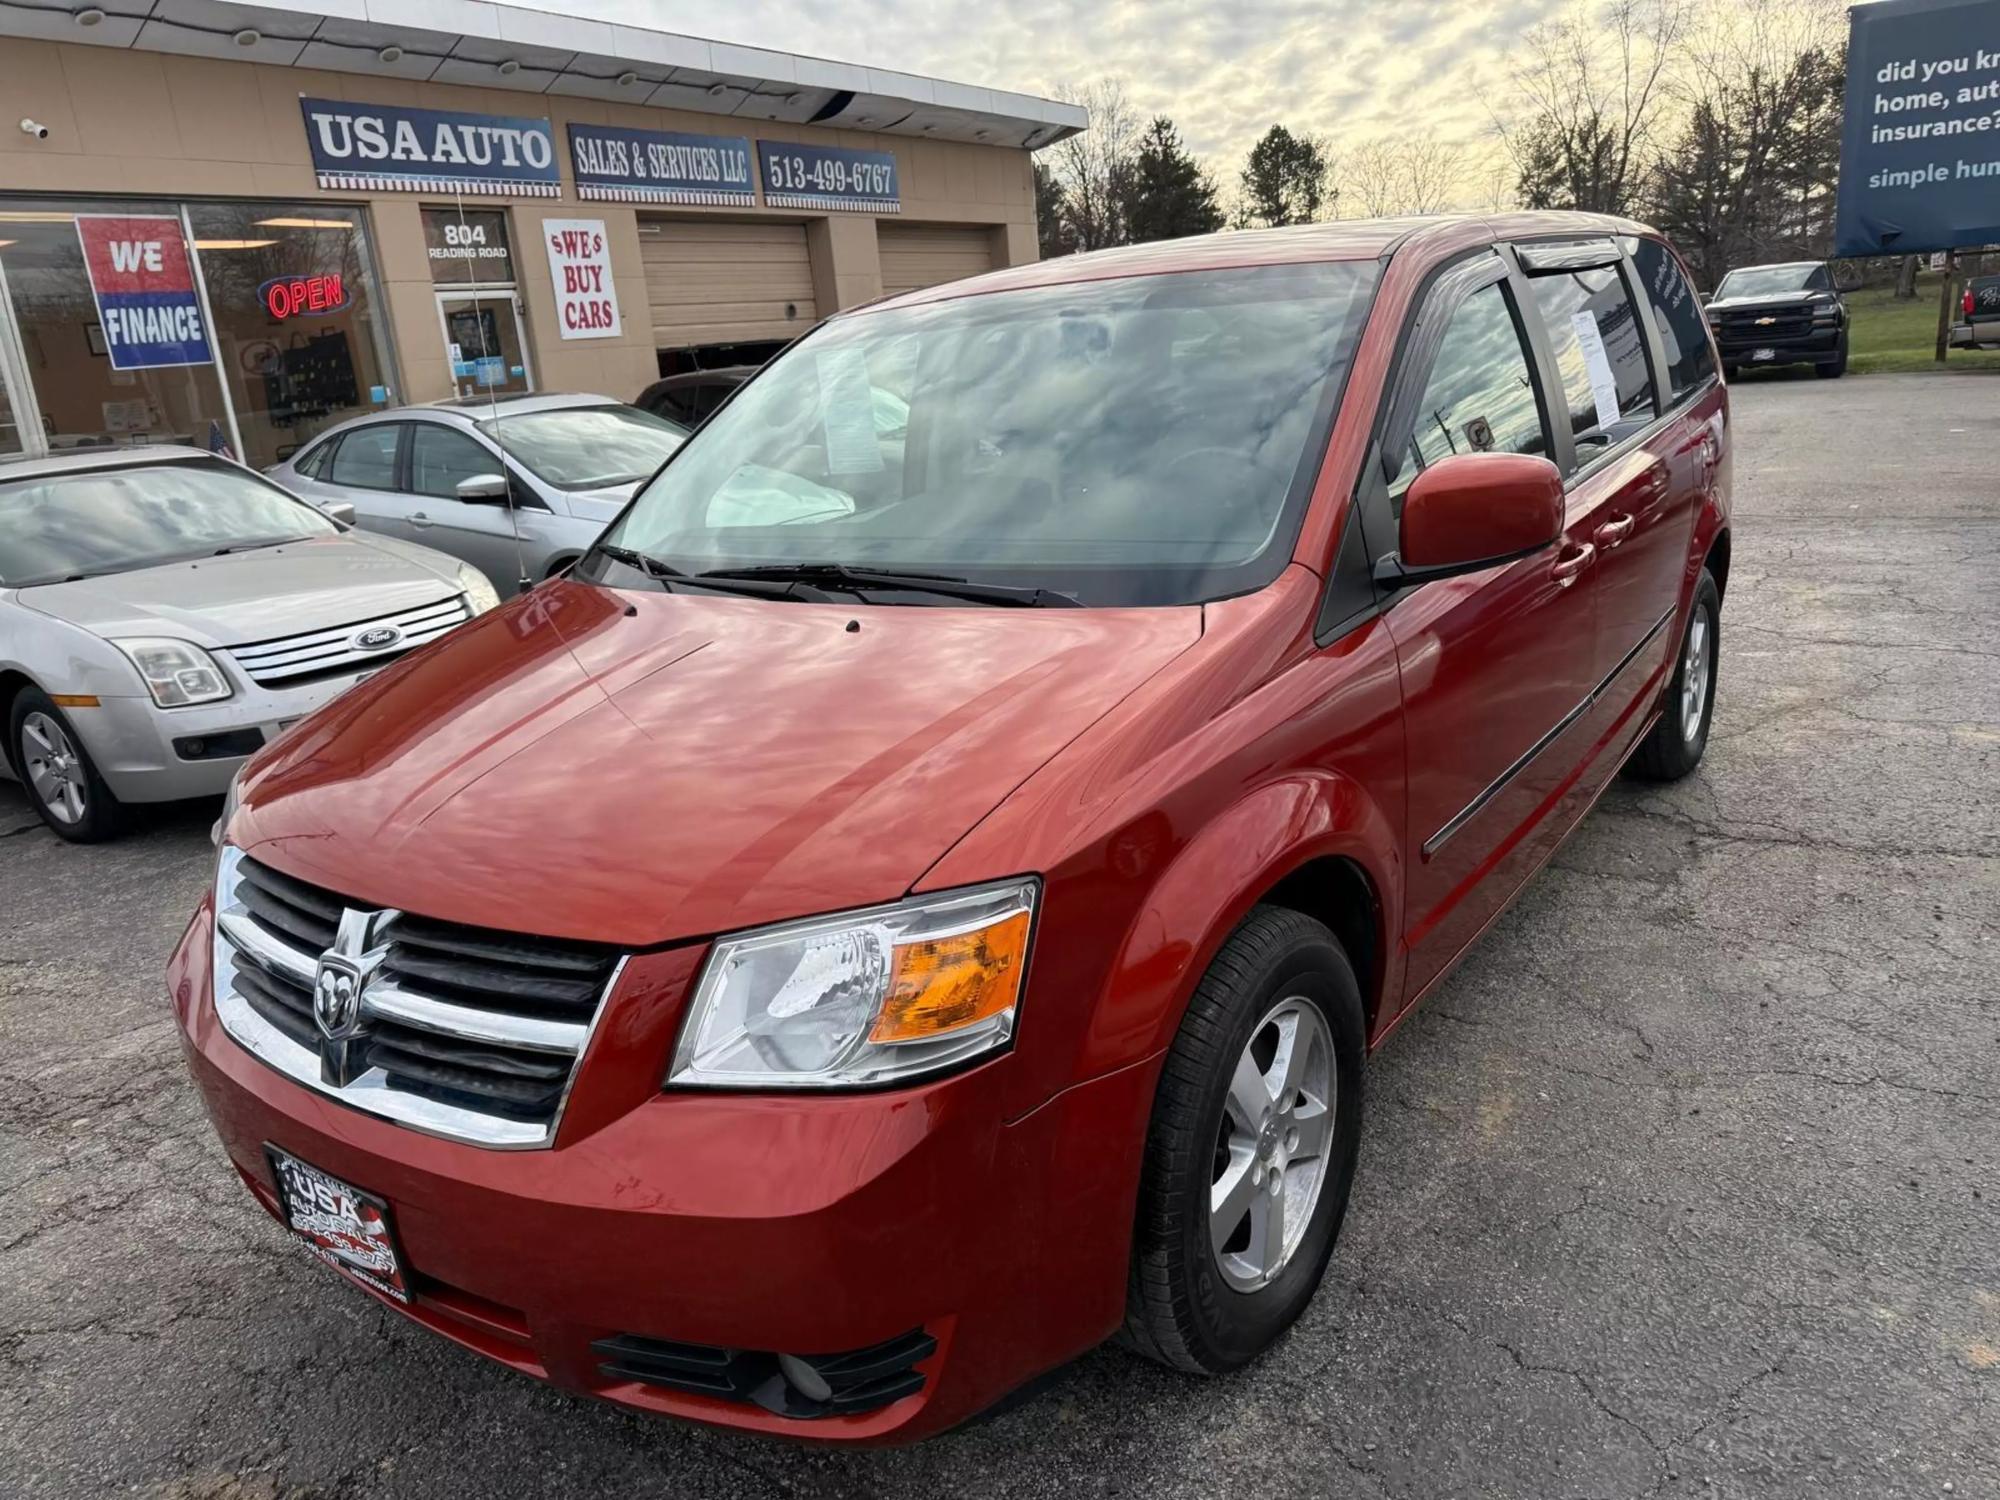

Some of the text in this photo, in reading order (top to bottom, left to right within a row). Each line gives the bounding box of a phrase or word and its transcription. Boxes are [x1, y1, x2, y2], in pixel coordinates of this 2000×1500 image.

[1877, 59, 1916, 83] did
[1921, 57, 1969, 83] you
[1874, 80, 2000, 114] home, aut
[311, 112, 551, 169] USA AUTO
[574, 136, 748, 184] SALES & SERVICES LLC
[769, 155, 892, 195] 513-499-6767
[1869, 162, 1950, 189] simple
[444, 225, 486, 246] 804
[109, 240, 163, 273] WE
[429, 247, 508, 259] READING ROAD
[563, 265, 603, 294] BUY
[268, 274, 342, 319] OPEN
[105, 305, 202, 346] FINANCE
[565, 300, 613, 330] CARS
[366, 629, 391, 644] Ford
[292, 1169, 364, 1230] USA
[290, 1193, 390, 1257] AUTO SALES
